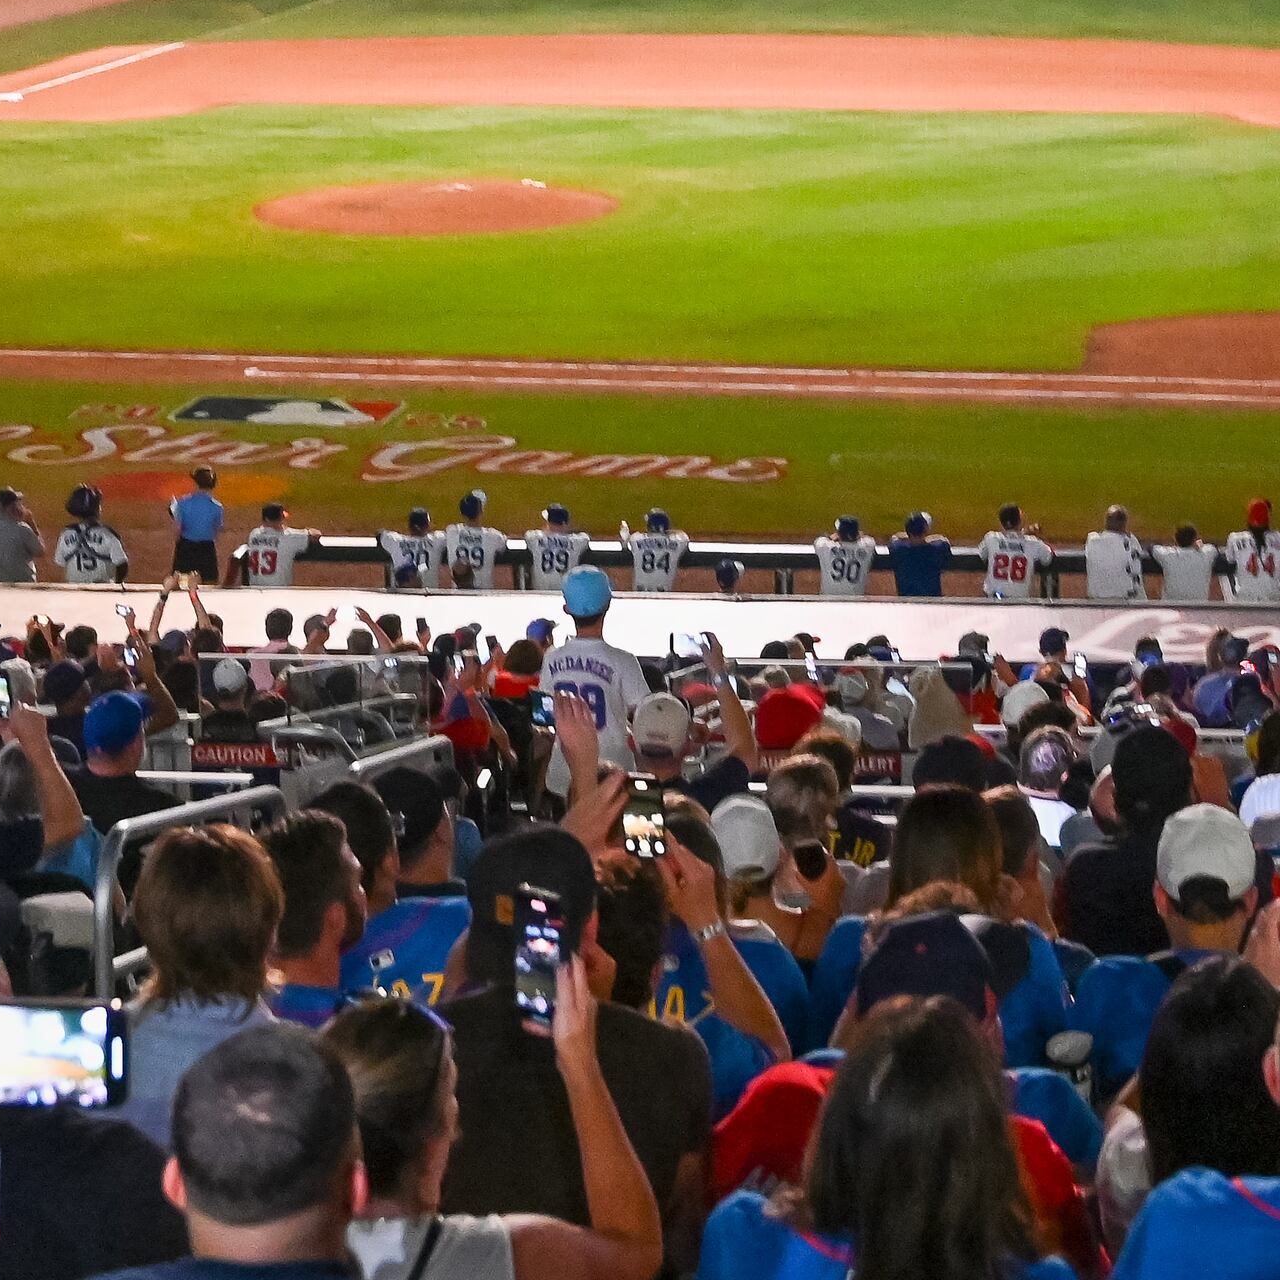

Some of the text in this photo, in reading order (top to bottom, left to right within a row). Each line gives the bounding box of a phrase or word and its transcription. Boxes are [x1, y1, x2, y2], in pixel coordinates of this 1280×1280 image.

[361, 434, 788, 481] Game
[541, 549, 570, 573] 89
[641, 550, 670, 573] 84
[830, 556, 861, 583] 90
[193, 747, 267, 765] CAUTION
